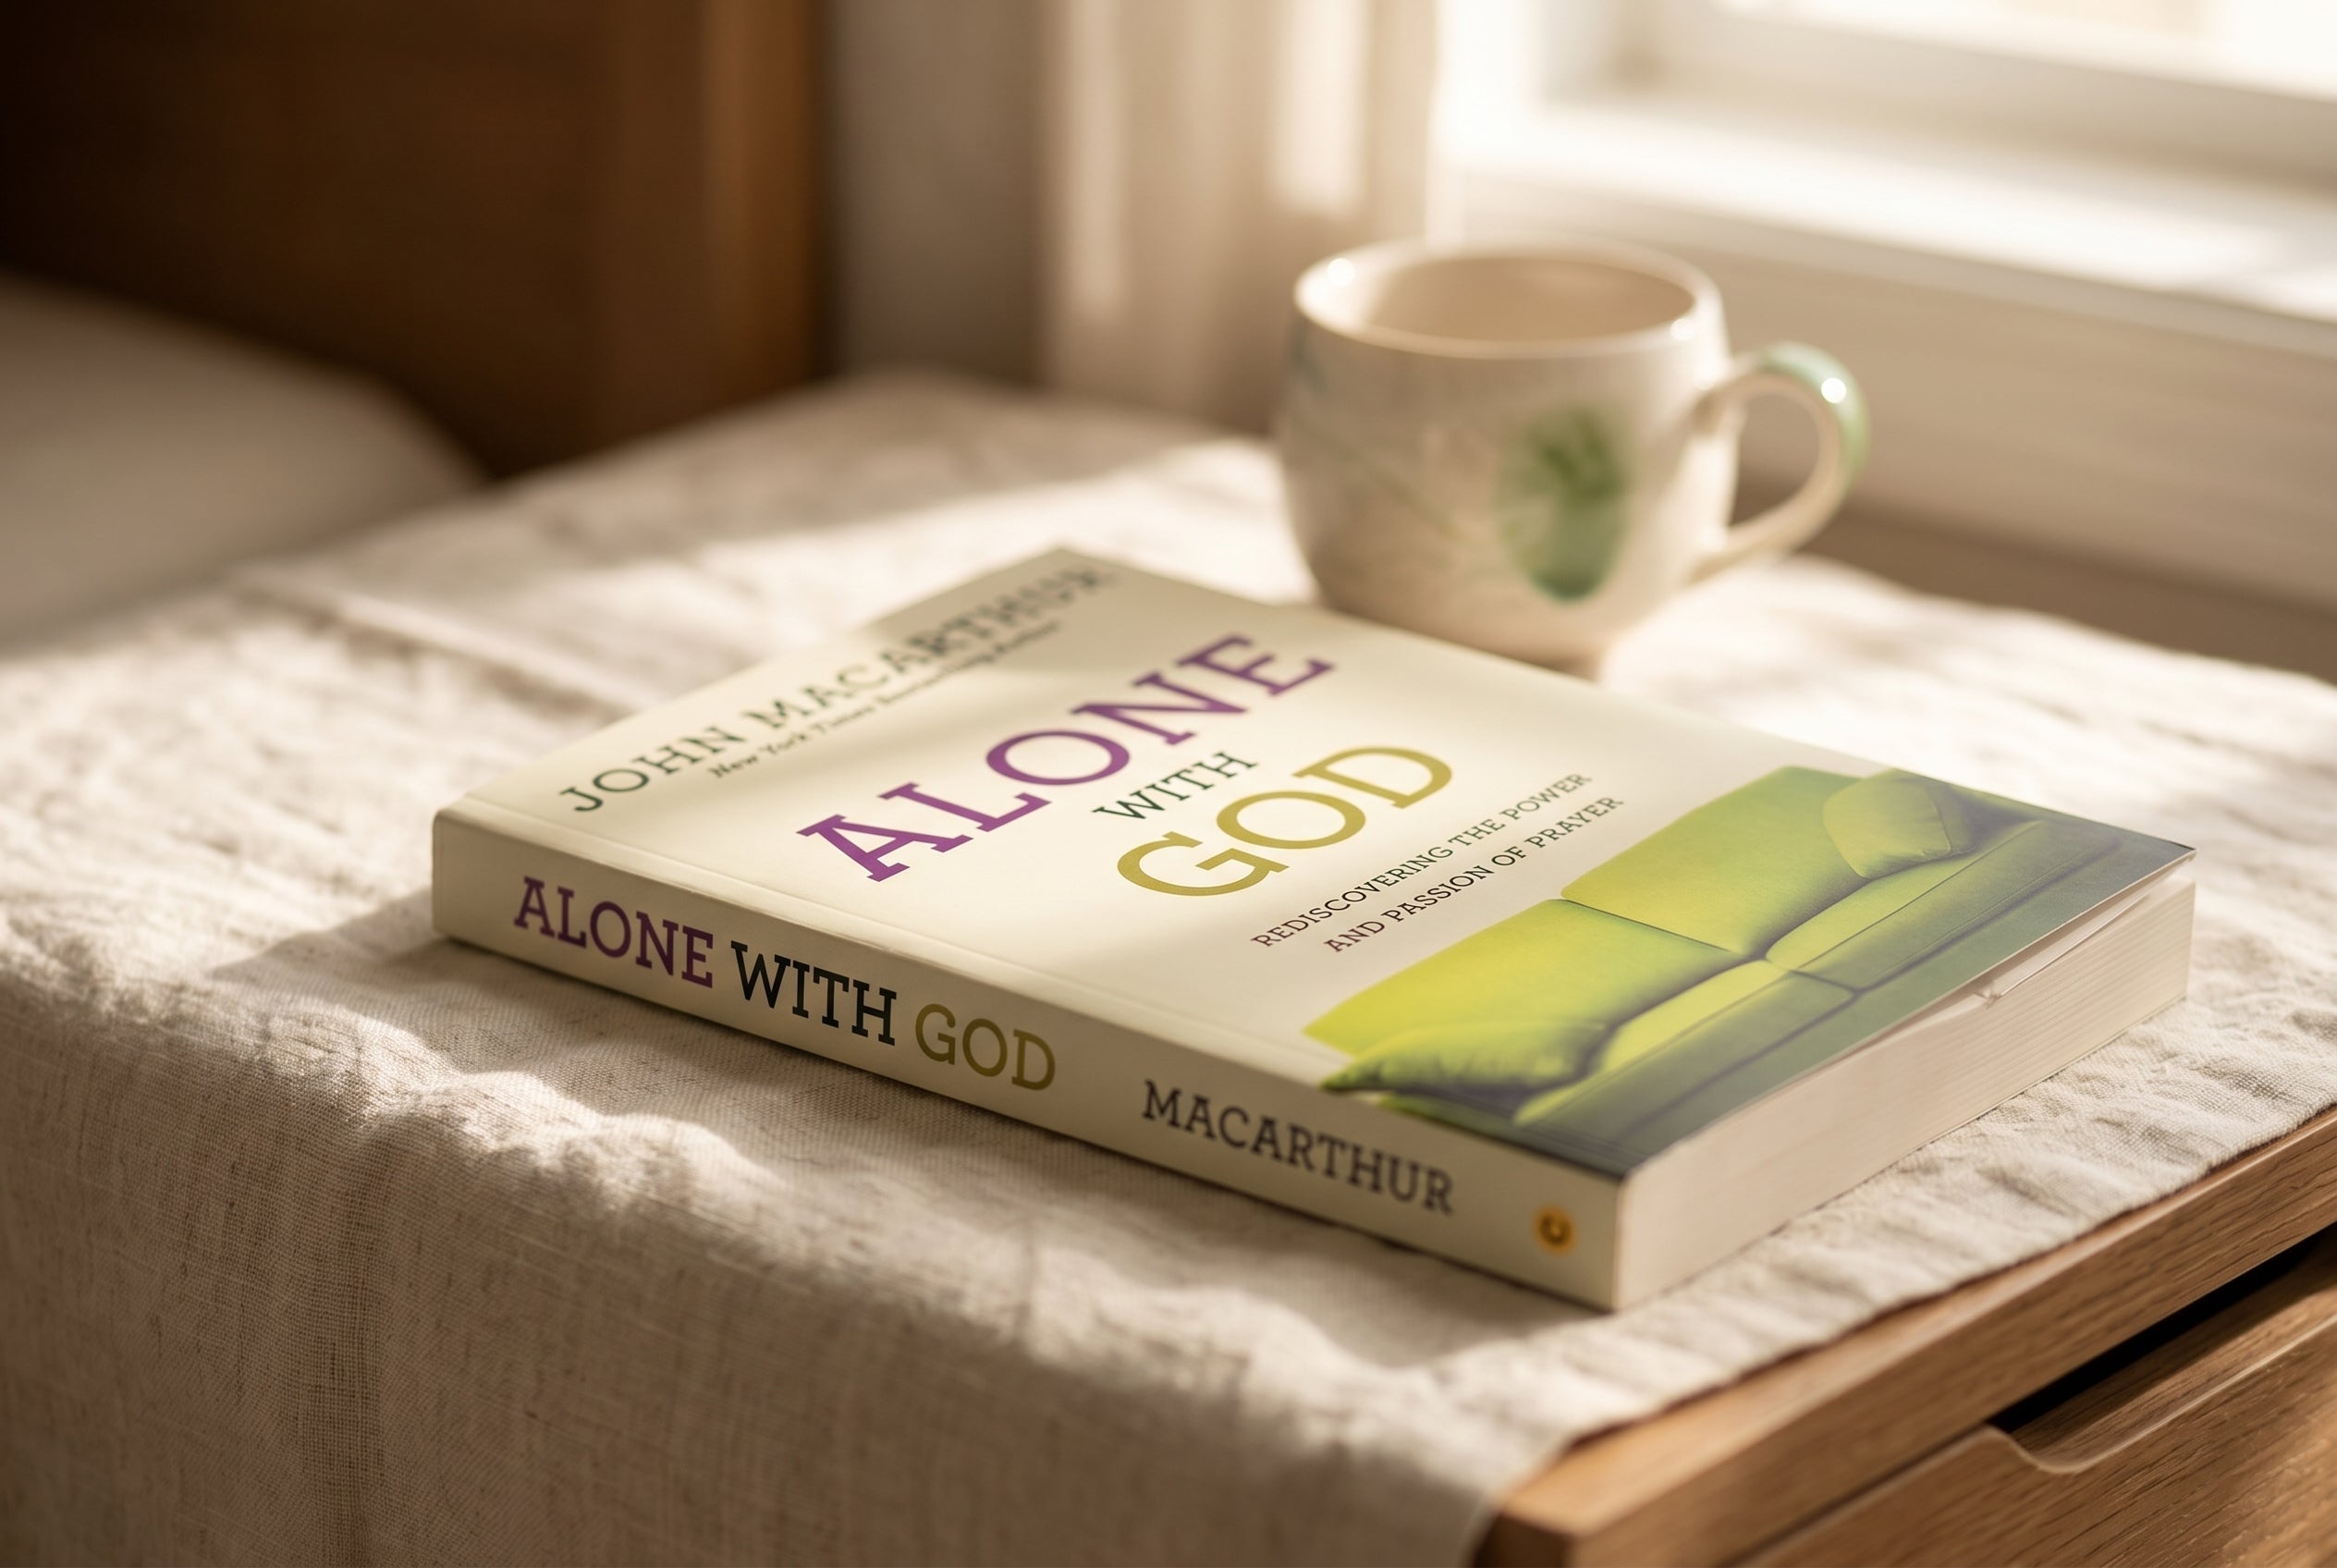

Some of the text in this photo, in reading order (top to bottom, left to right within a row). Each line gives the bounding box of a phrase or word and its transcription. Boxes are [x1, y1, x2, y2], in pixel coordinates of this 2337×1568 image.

[559, 567, 1116, 813] JOHN MACARTHUR
[707, 755, 758, 778] New
[796, 633, 1336, 882] ALONE
[1091, 751, 1259, 821] WITH
[1116, 746, 1452, 897] GOD
[1250, 773, 1593, 947] REDISCOVERING THE POWER
[1324, 796, 1624, 952] AND PASSION OF PRAYER
[514, 876, 1056, 1091] ALONE WITH GOD
[1142, 1079, 1454, 1214] MACARTHUR
